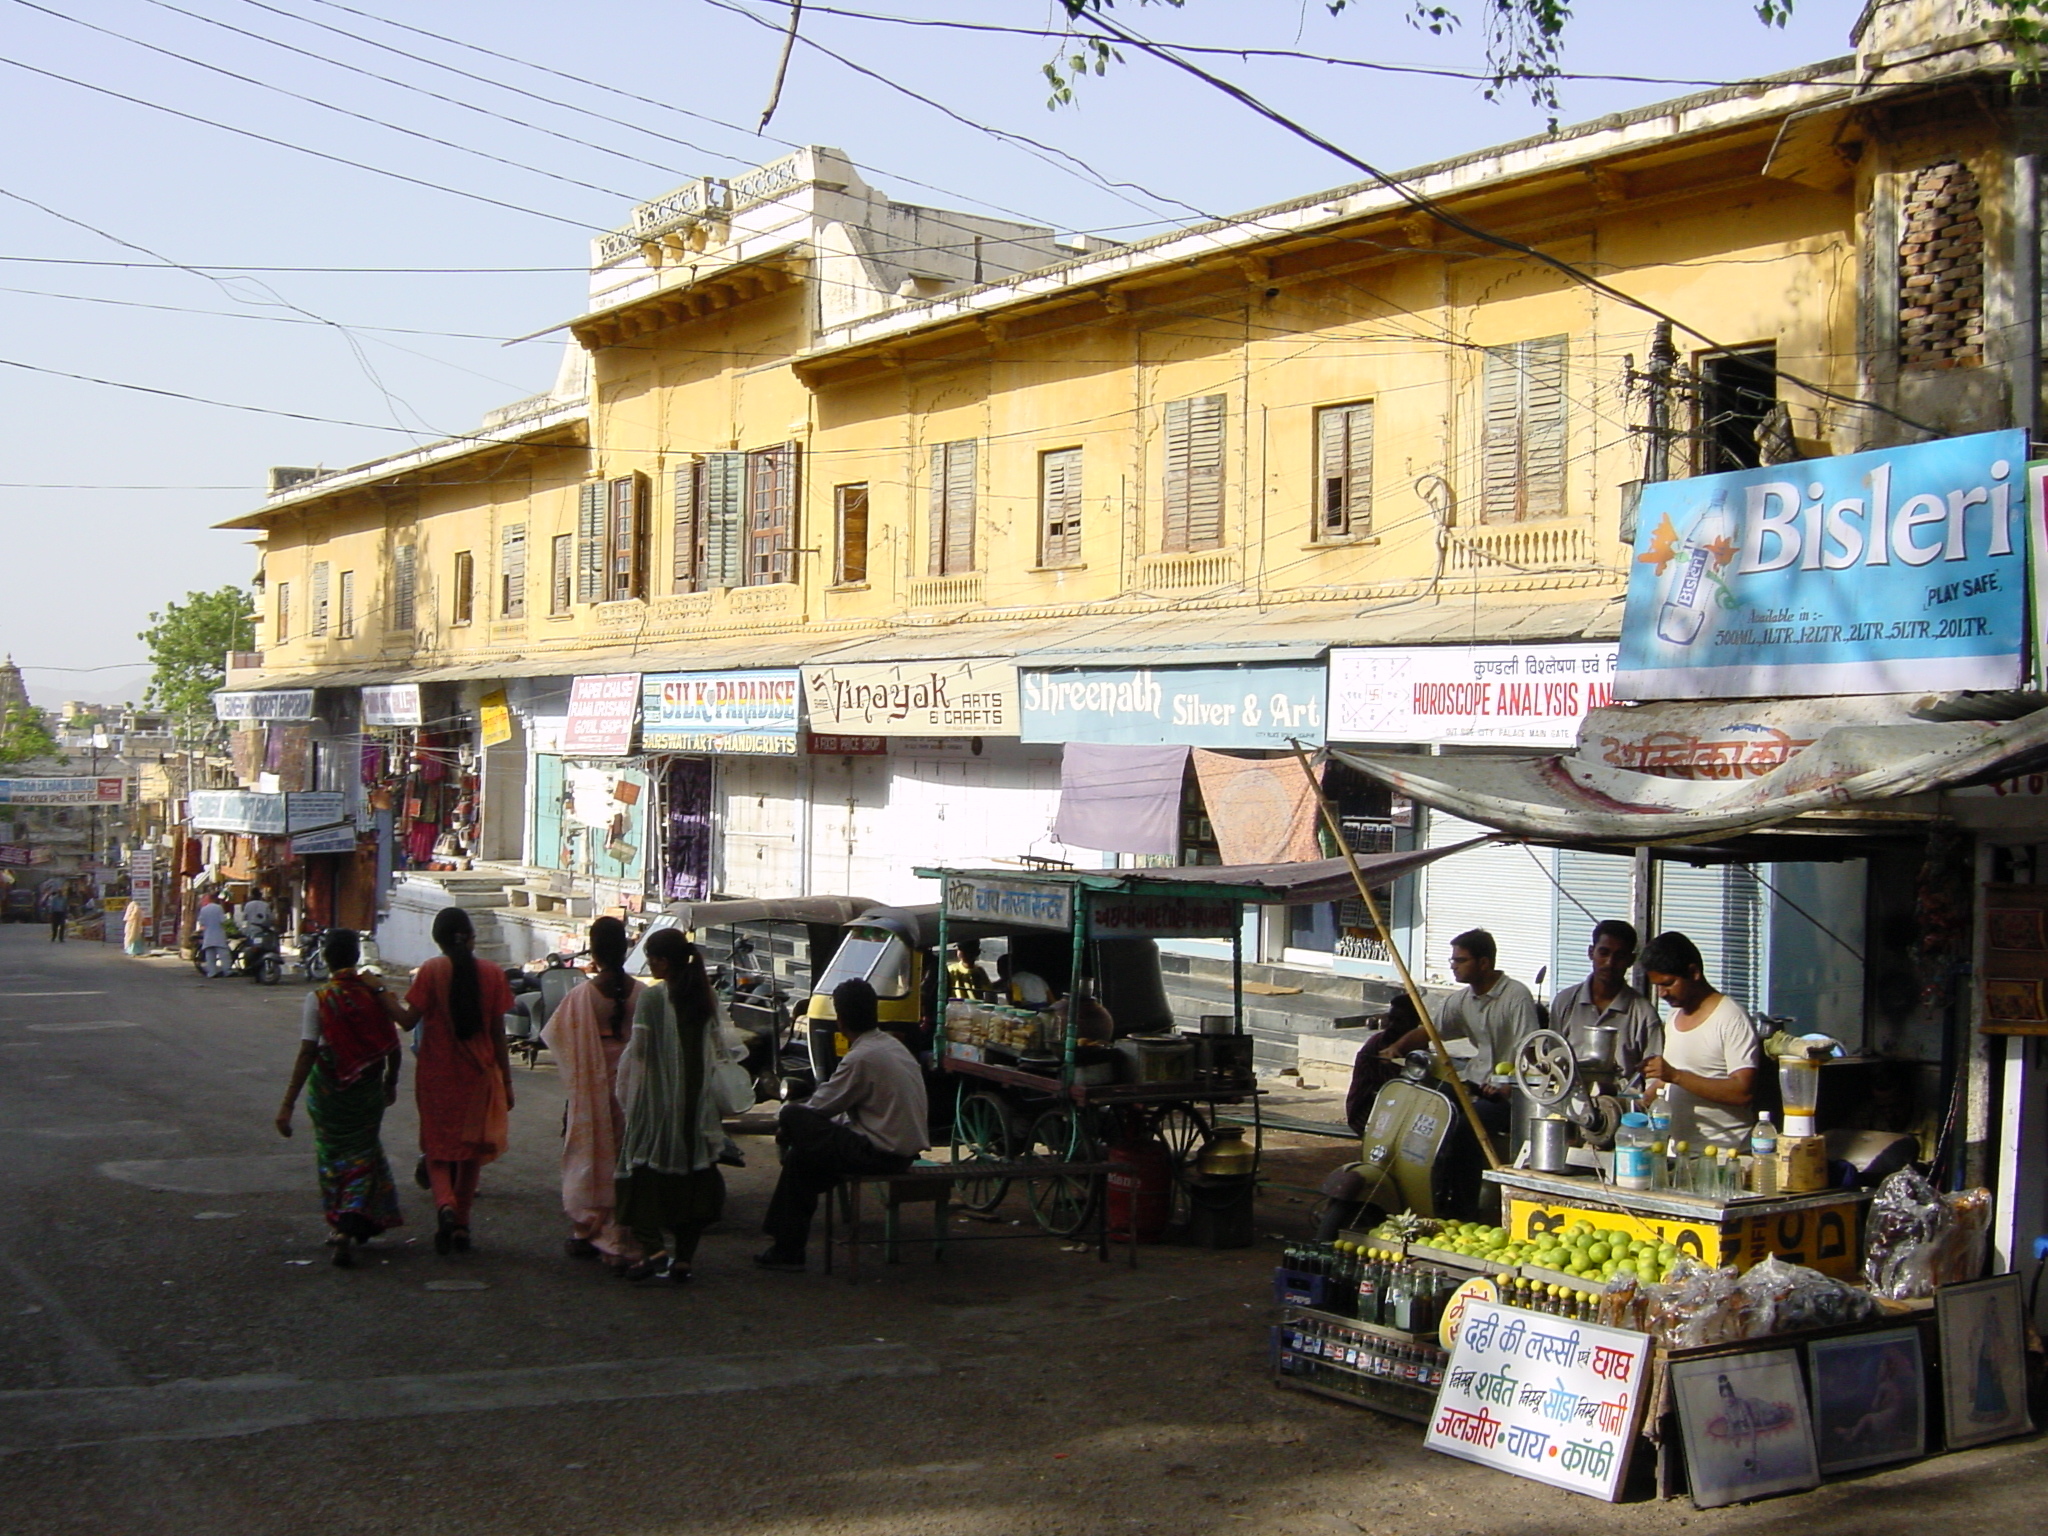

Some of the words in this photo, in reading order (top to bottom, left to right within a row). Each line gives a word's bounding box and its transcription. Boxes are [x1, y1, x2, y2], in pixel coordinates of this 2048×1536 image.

[1737, 459, 2014, 575] Bisleri
[1679, 555, 1706, 606] Bisleri
[1928, 582, 1960, 606] PLAY
[1963, 573, 1998, 596] SAFE
[1473, 655, 1520, 681] कुण्डली
[1525, 655, 1577, 676] विश्लेषण
[1581, 653, 1600, 674] एवं
[663, 682, 712, 723] SILK
[715, 680, 796, 725] PARADISE
[811, 673, 951, 724] Vinayak
[962, 693, 1003, 708] ARTS
[944, 710, 1003, 725] CRAFTS
[1024, 670, 1161, 719] Shreenath
[1172, 692, 1236, 727] Silver
[1241, 692, 1262, 727] &
[1269, 692, 1321, 728] Art
[1413, 682, 1491, 716] HOROSCOPE
[1496, 682, 1578, 716] ANALYSIS
[723, 733, 797, 755] HANDICRAFTS
[1478, 728, 1495, 738] CITY
[1498, 728, 1526, 738] PALACE
[1529, 729, 1547, 738] MAIN
[1551, 729, 1570, 739] GATE
[1465, 1313, 1499, 1354] दही
[1499, 1319, 1526, 1356] की
[1525, 1329, 1580, 1368] लस्सी
[1592, 1345, 1634, 1383] छाछ
[1475, 1364, 1518, 1407] शर्बत
[1599, 1393, 1628, 1436] पानी
[1436, 1406, 1501, 1449] जलजीरा
[1508, 1424, 1550, 1463] चाय
[1561, 1436, 1615, 1482] कॉफी
